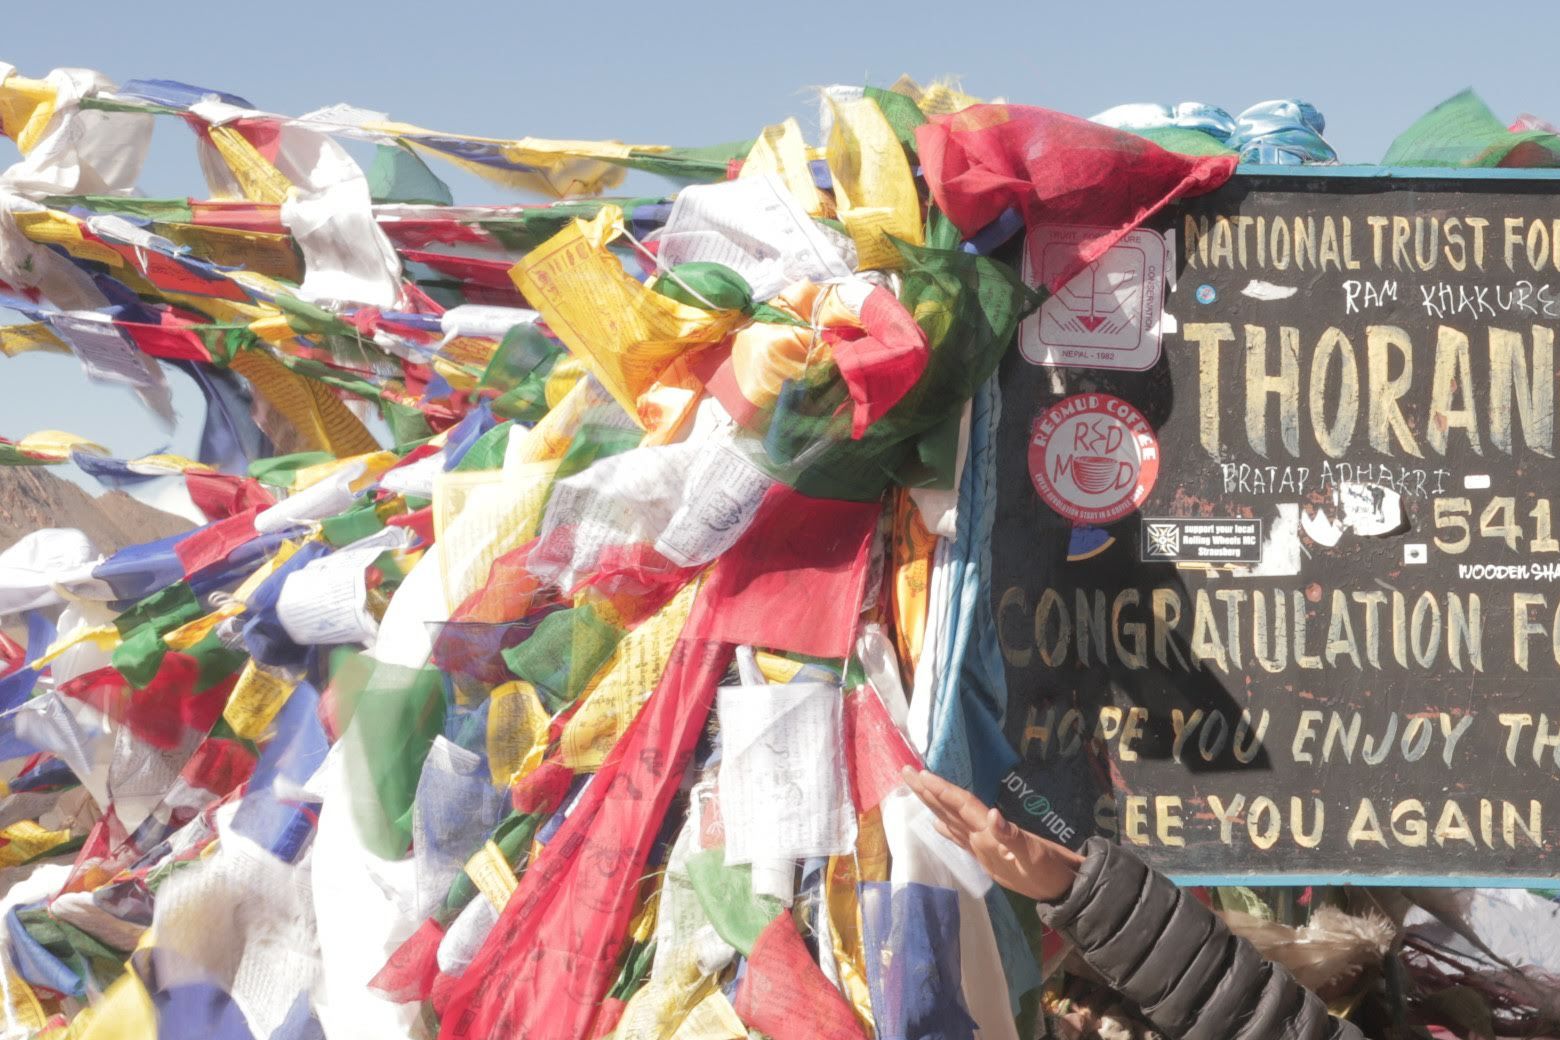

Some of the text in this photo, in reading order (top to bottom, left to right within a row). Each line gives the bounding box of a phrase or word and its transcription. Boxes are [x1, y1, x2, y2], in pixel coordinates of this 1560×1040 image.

[1184, 214, 1360, 270] NATIONAL
[1366, 214, 1490, 272] TRUST
[1143, 265, 1157, 331] CONSERVATION
[1342, 280, 1397, 314] RAM
[1062, 350, 1089, 359] NEPAL
[1096, 352, 1115, 360] 1982
[1033, 396, 1157, 460] REDMUD COFFEE
[1183, 535, 1256, 545] Rolling Wheels MC
[1184, 524, 1255, 534] support your local
[1459, 564, 1530, 580] WOODEN
[997, 585, 1482, 673] CONGRATULATION
[1171, 708, 1269, 764] YOU
[1293, 709, 1474, 770] ENJOY
[1001, 771, 1034, 799] JOY
[1093, 793, 1544, 850] SEE YOU AGAIN
